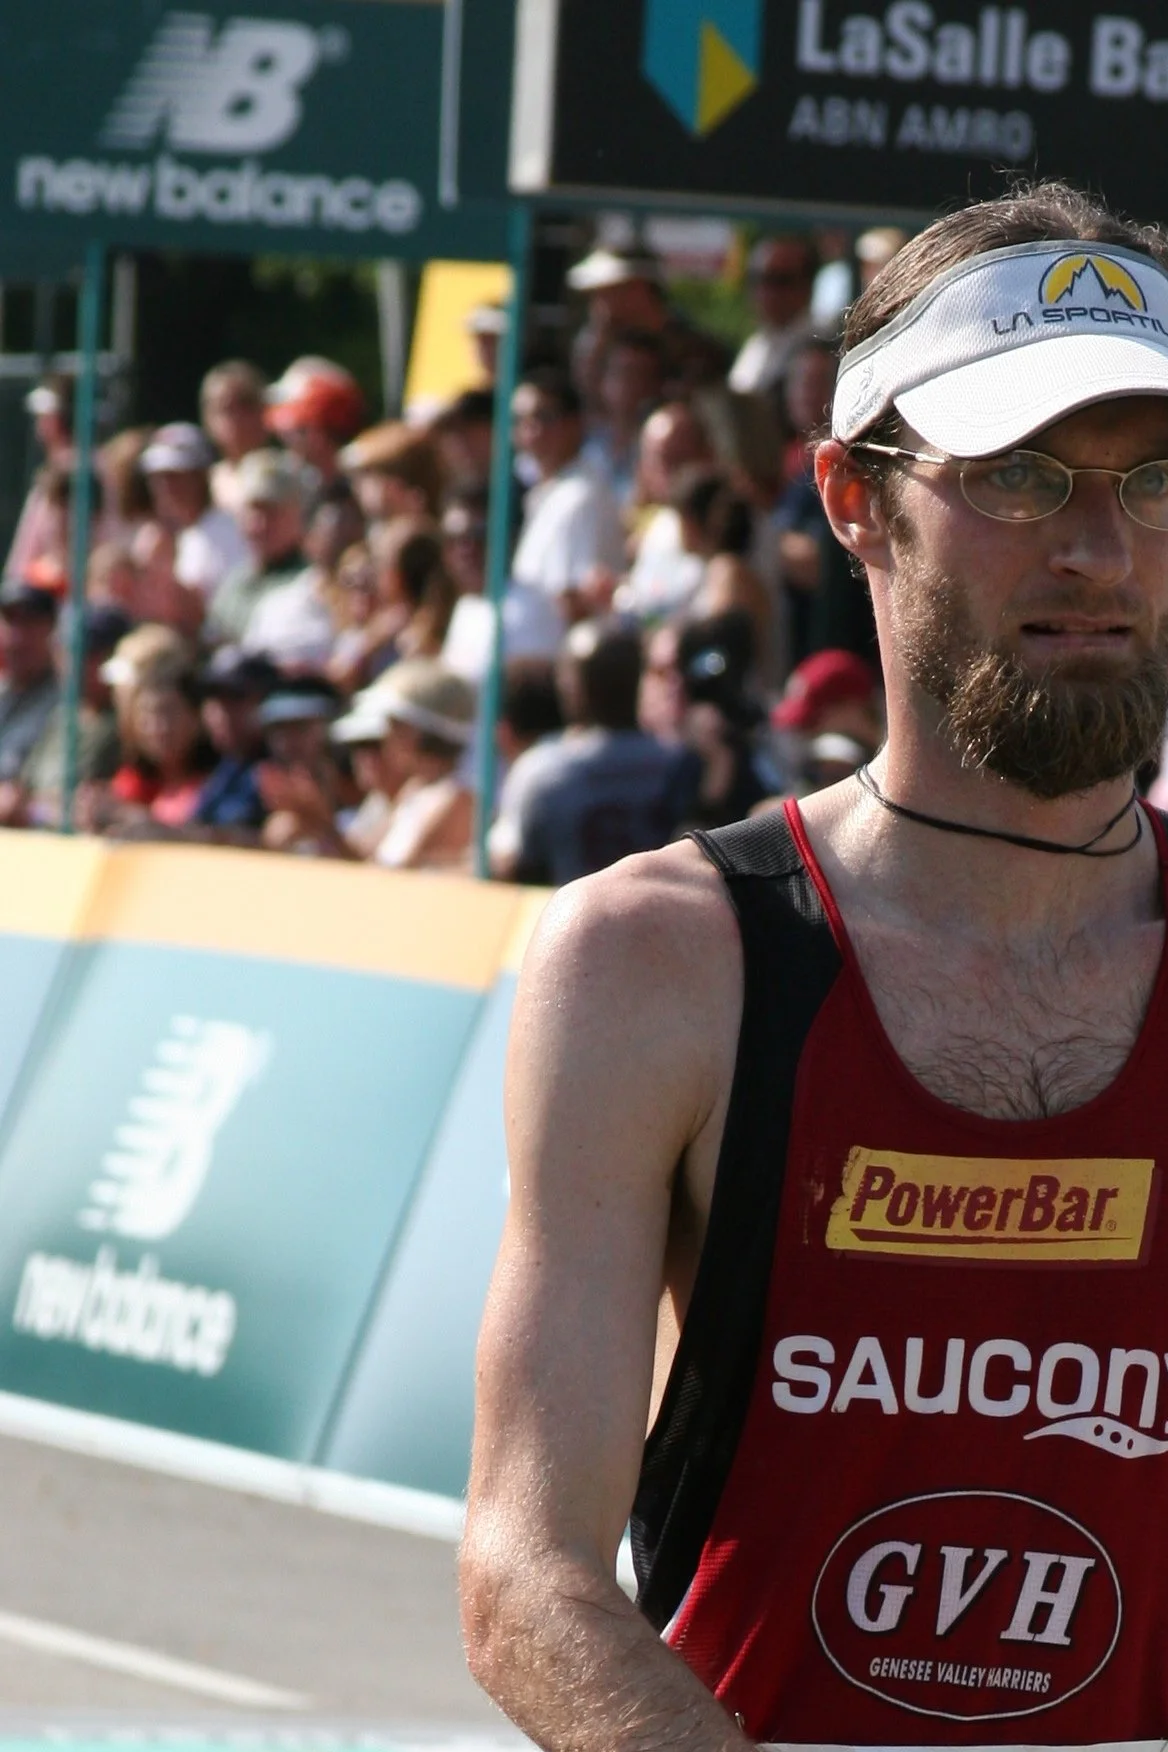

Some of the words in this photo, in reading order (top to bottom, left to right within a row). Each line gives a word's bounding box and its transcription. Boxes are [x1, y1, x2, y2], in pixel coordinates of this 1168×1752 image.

[796, 0, 1072, 91] LaSalle
[787, 94, 889, 148] ABN
[896, 102, 1035, 161] AMRO
[992, 310, 1035, 336] LA
[849, 1164, 1119, 1233] PowerBar
[868, 1656, 933, 1682] GENESEE
[936, 1661, 987, 1688] VALLEY
[985, 1667, 1052, 1694] HARRIERS
